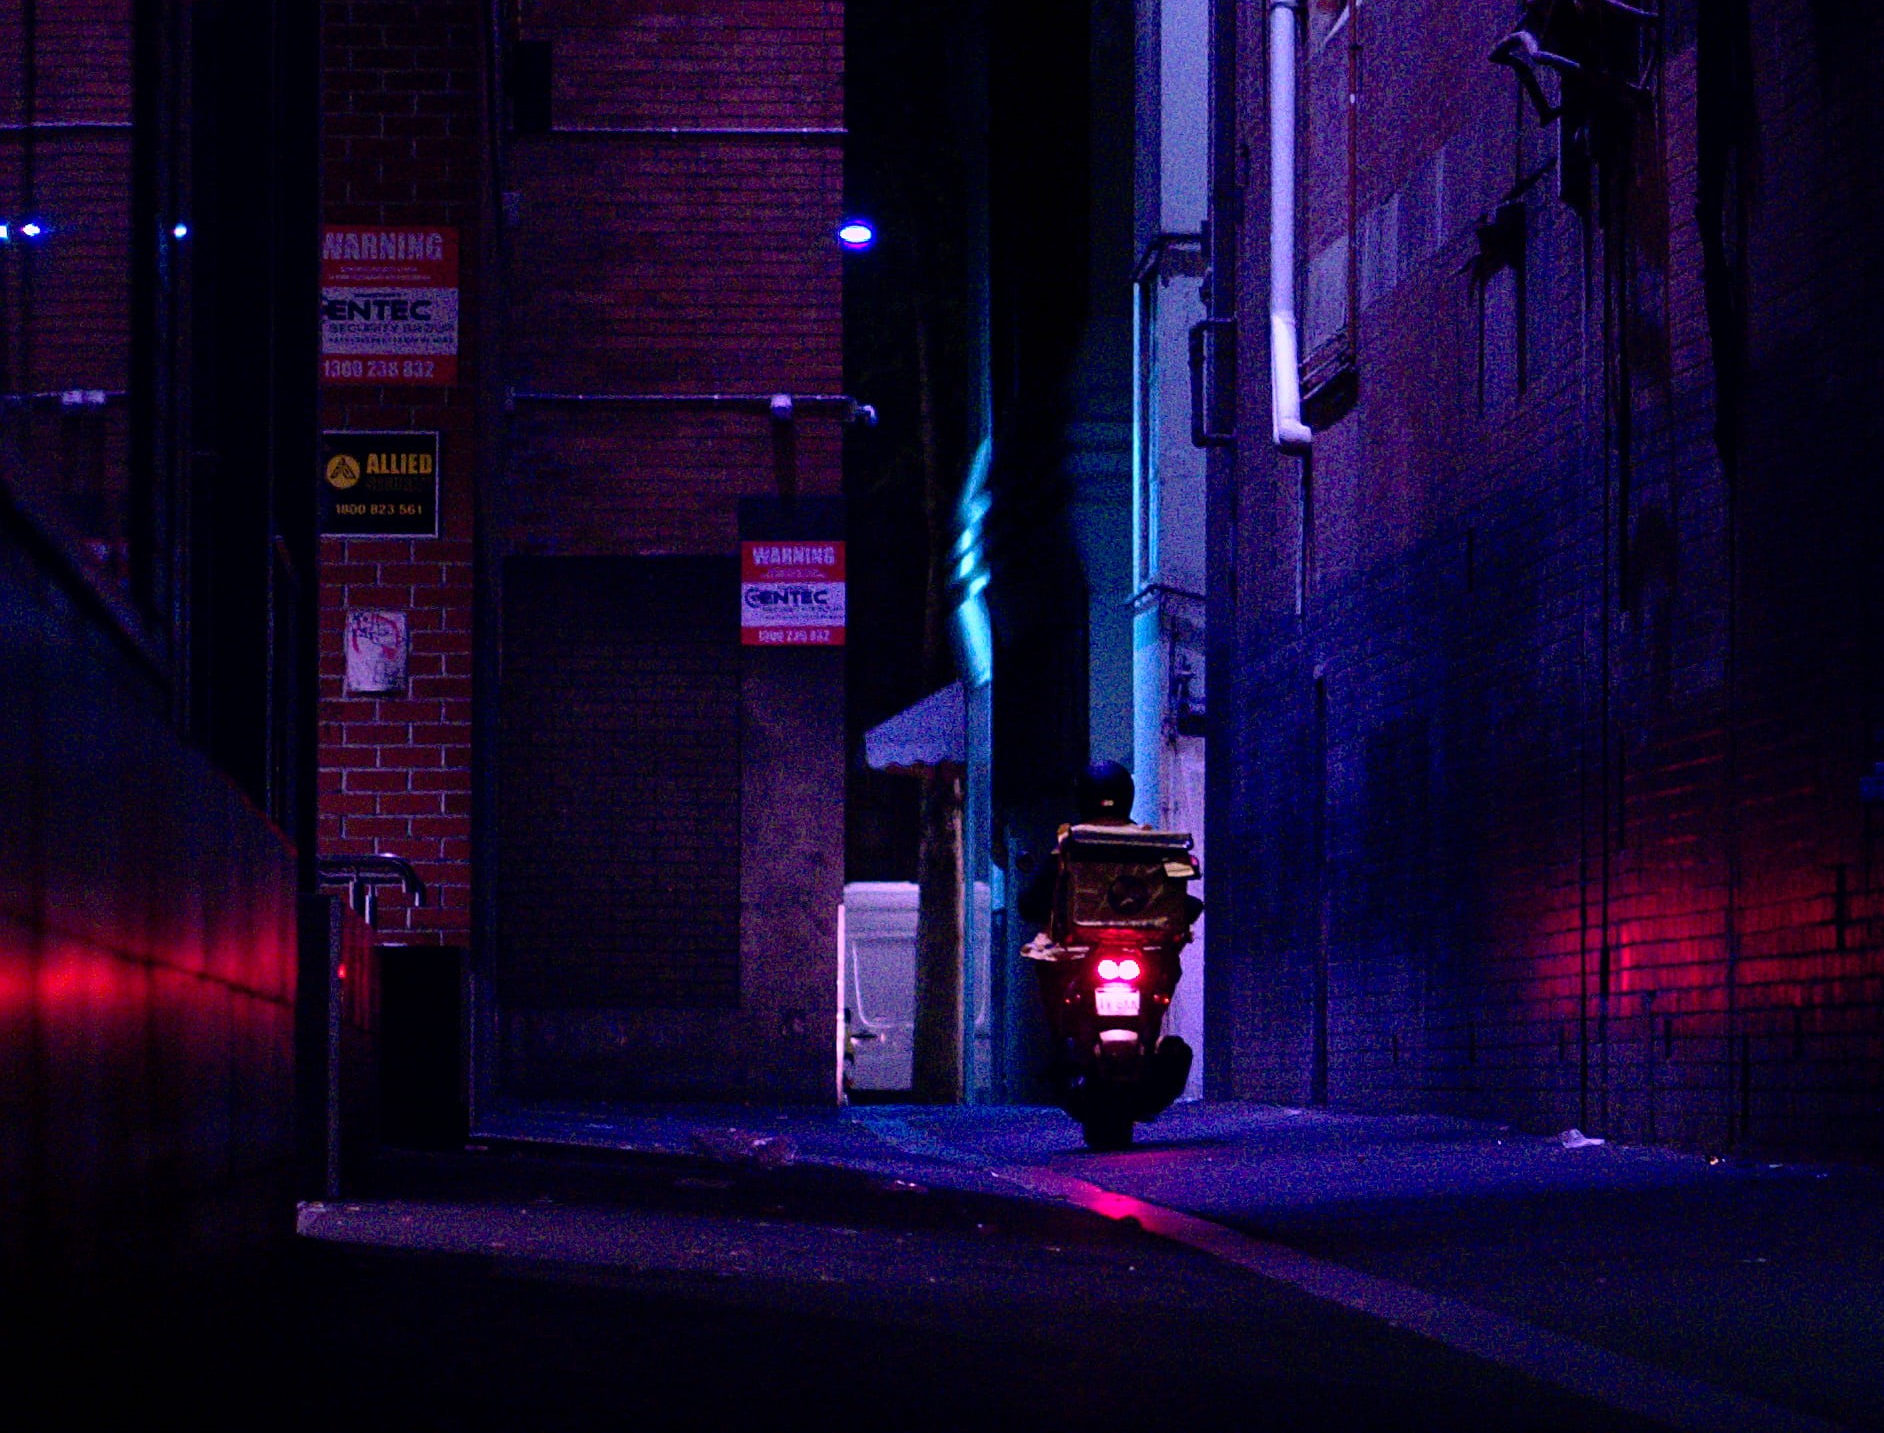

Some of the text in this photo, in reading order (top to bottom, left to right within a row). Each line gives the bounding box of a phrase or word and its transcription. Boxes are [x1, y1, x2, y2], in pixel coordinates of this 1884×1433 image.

[322, 231, 444, 261] WARNING
[402, 359, 435, 379] 832
[365, 452, 433, 475] ALLIED
[335, 503, 423, 515] 1800 823 561
[752, 546, 836, 566] WARNING
